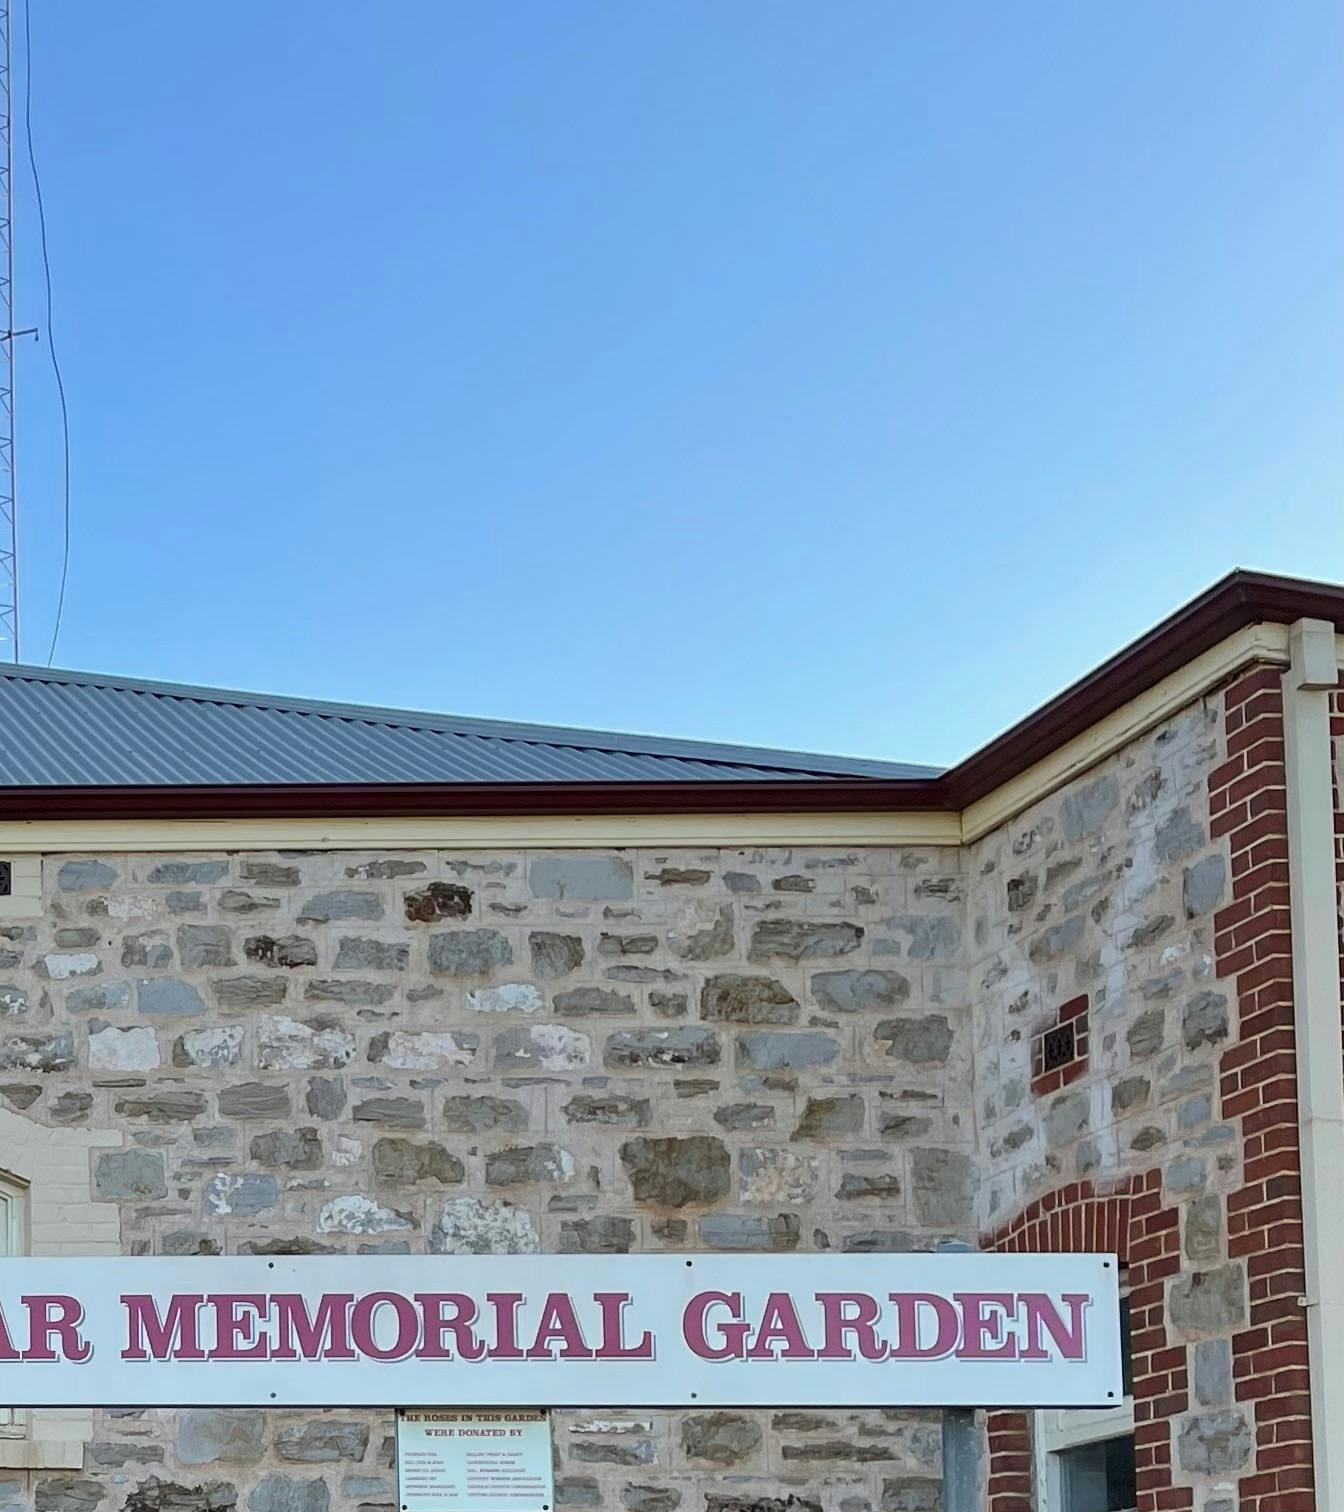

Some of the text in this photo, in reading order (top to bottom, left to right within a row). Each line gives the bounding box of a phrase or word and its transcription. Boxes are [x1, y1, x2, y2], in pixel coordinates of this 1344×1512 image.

[119, 1293, 655, 1363] MEMORIAL
[682, 1291, 1092, 1363] GARDEN
[400, 1414, 547, 1422] THE ROSES IN THIS GARDEN
[424, 1429, 523, 1437] WERE DONATED BY
